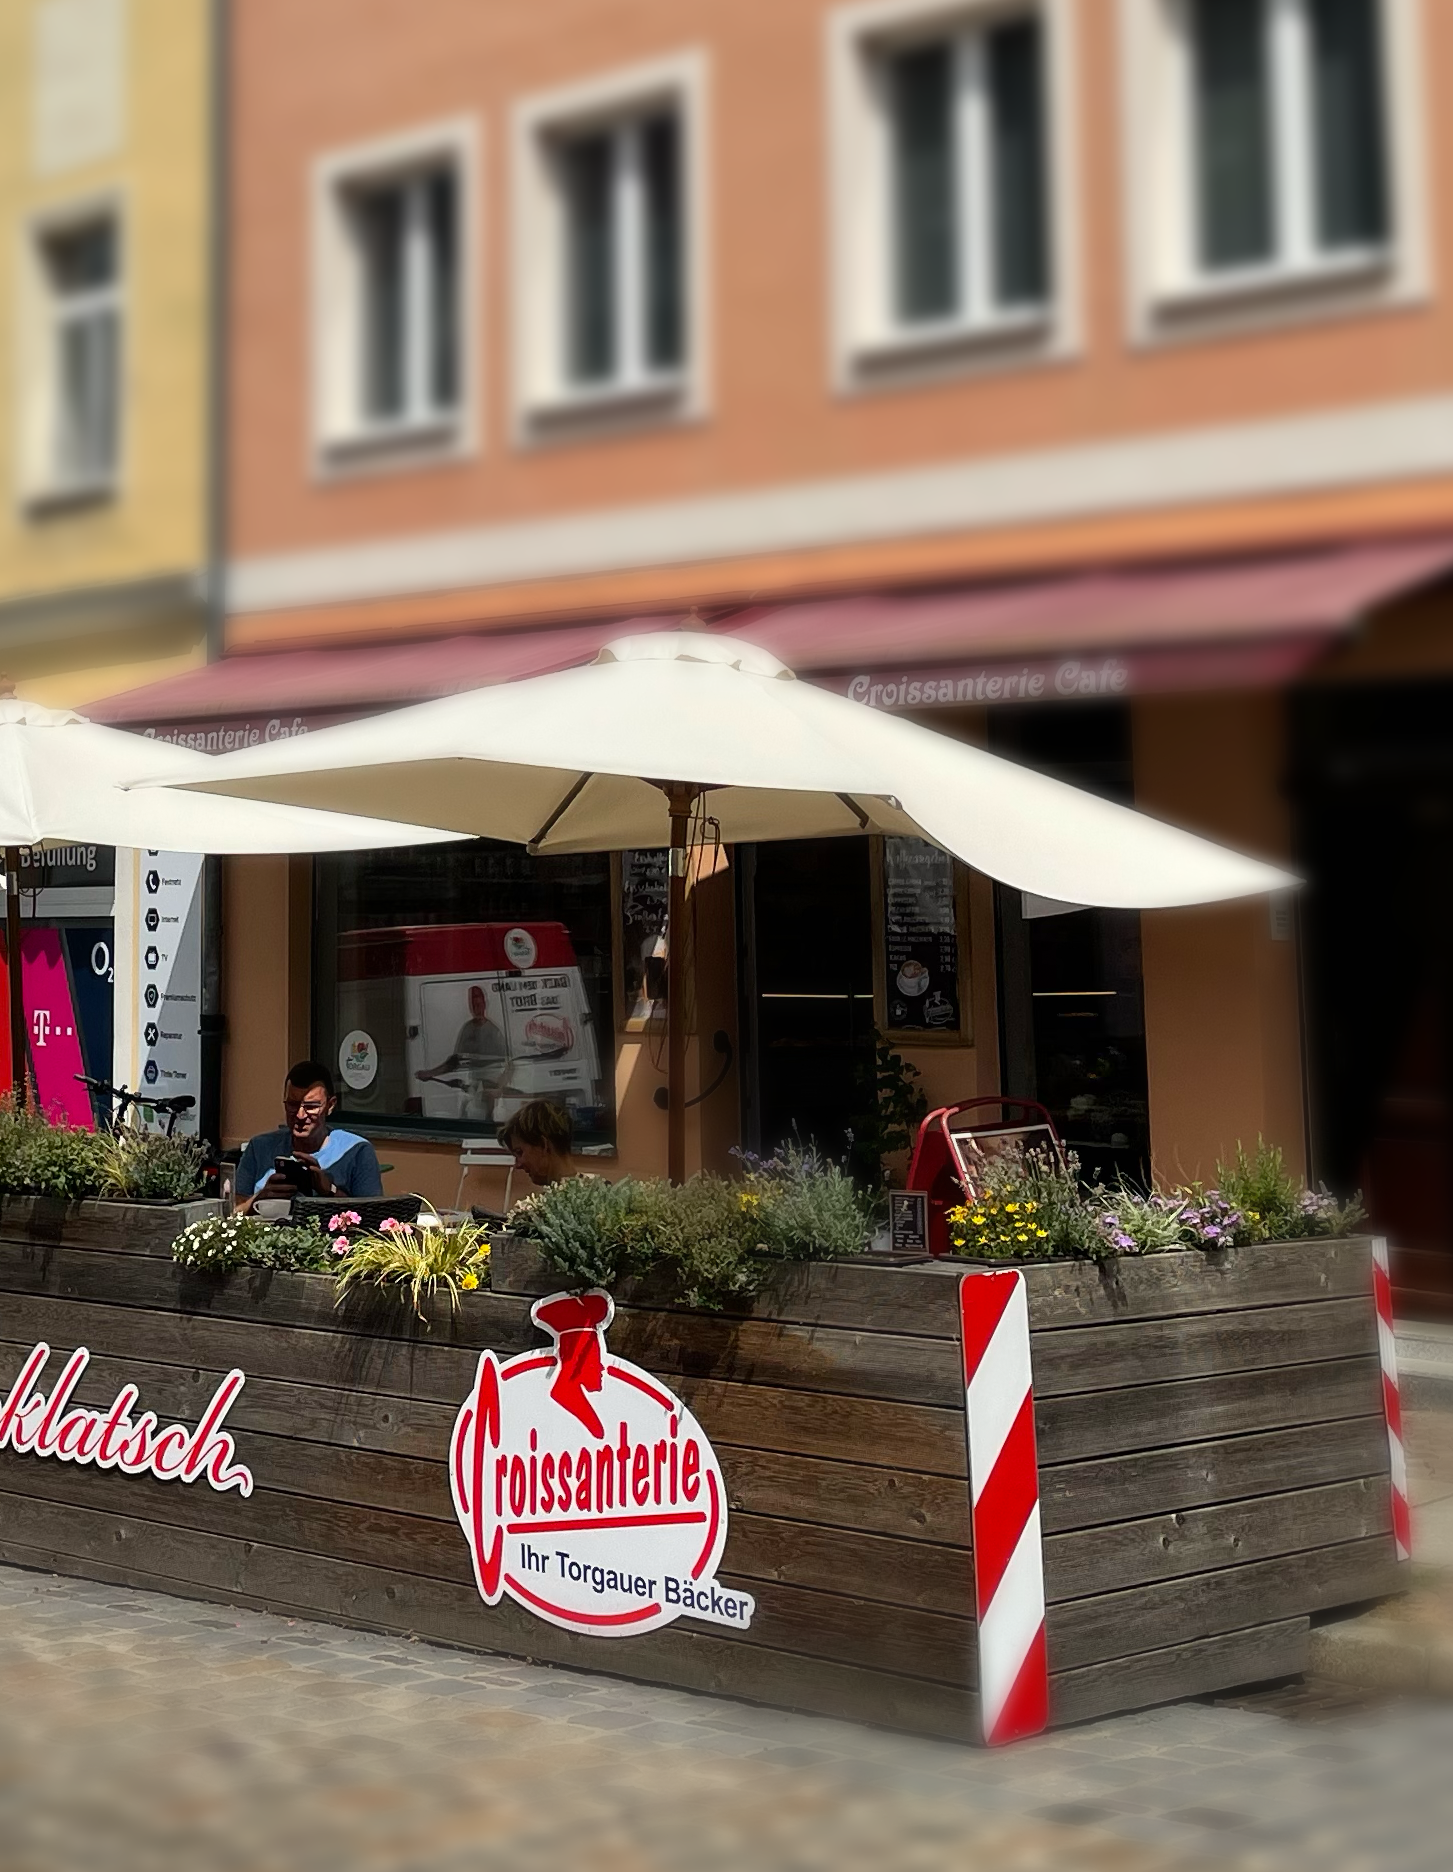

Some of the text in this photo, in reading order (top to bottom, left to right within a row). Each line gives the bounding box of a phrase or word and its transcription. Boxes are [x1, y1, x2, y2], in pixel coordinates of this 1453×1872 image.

[847, 668, 1046, 706] Croissanterie
[472, 1356, 700, 1598] Croissanterie
[520, 1542, 748, 1621] Ihr Torgauer Bäcker
